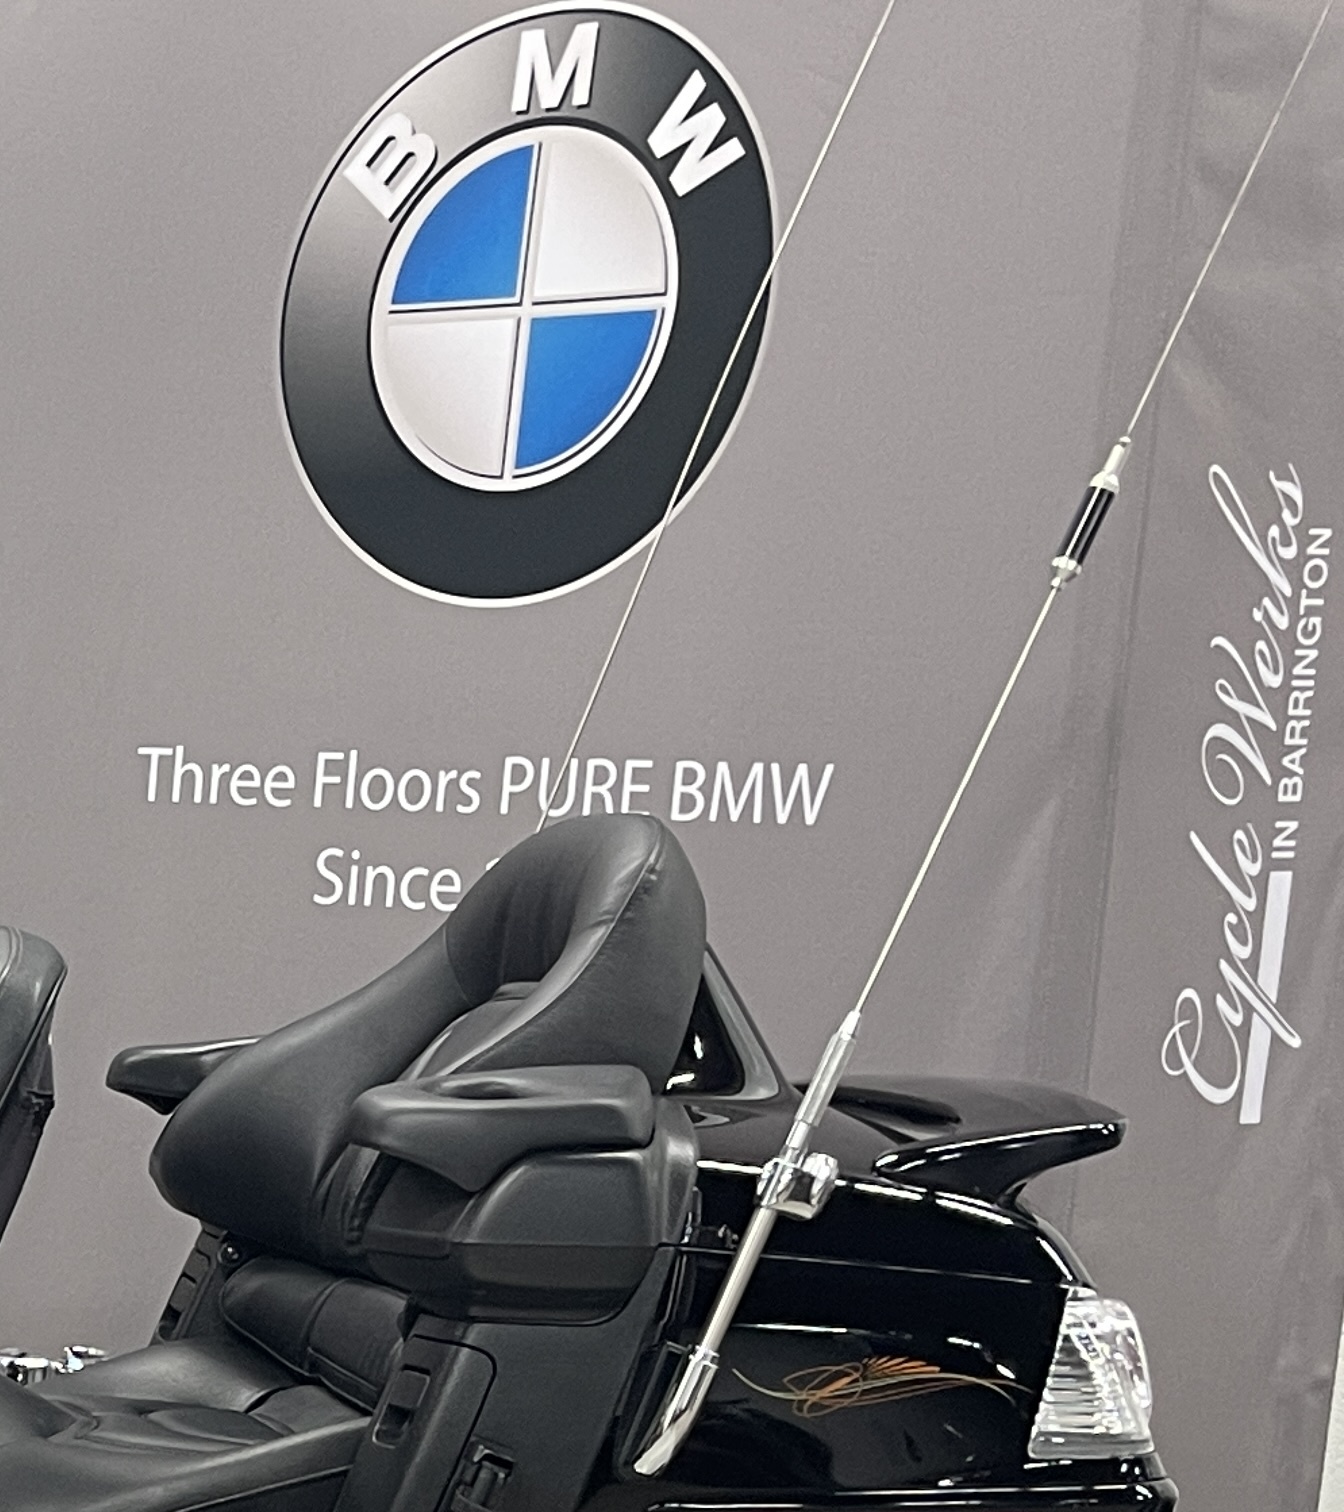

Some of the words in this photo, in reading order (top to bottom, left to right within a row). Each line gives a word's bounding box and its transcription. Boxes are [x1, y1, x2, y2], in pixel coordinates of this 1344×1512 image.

[343, 20, 747, 223] BMW
[1201, 462, 1304, 806] Werks
[1277, 526, 1333, 803] BARRINGTON
[137, 744, 296, 808] Three
[313, 749, 482, 814] Floors
[499, 755, 654, 817] PURE
[670, 760, 835, 826] BMW
[312, 847, 462, 912] Since
[1270, 820, 1299, 860] IN
[1160, 822, 1302, 1104] Cycle
